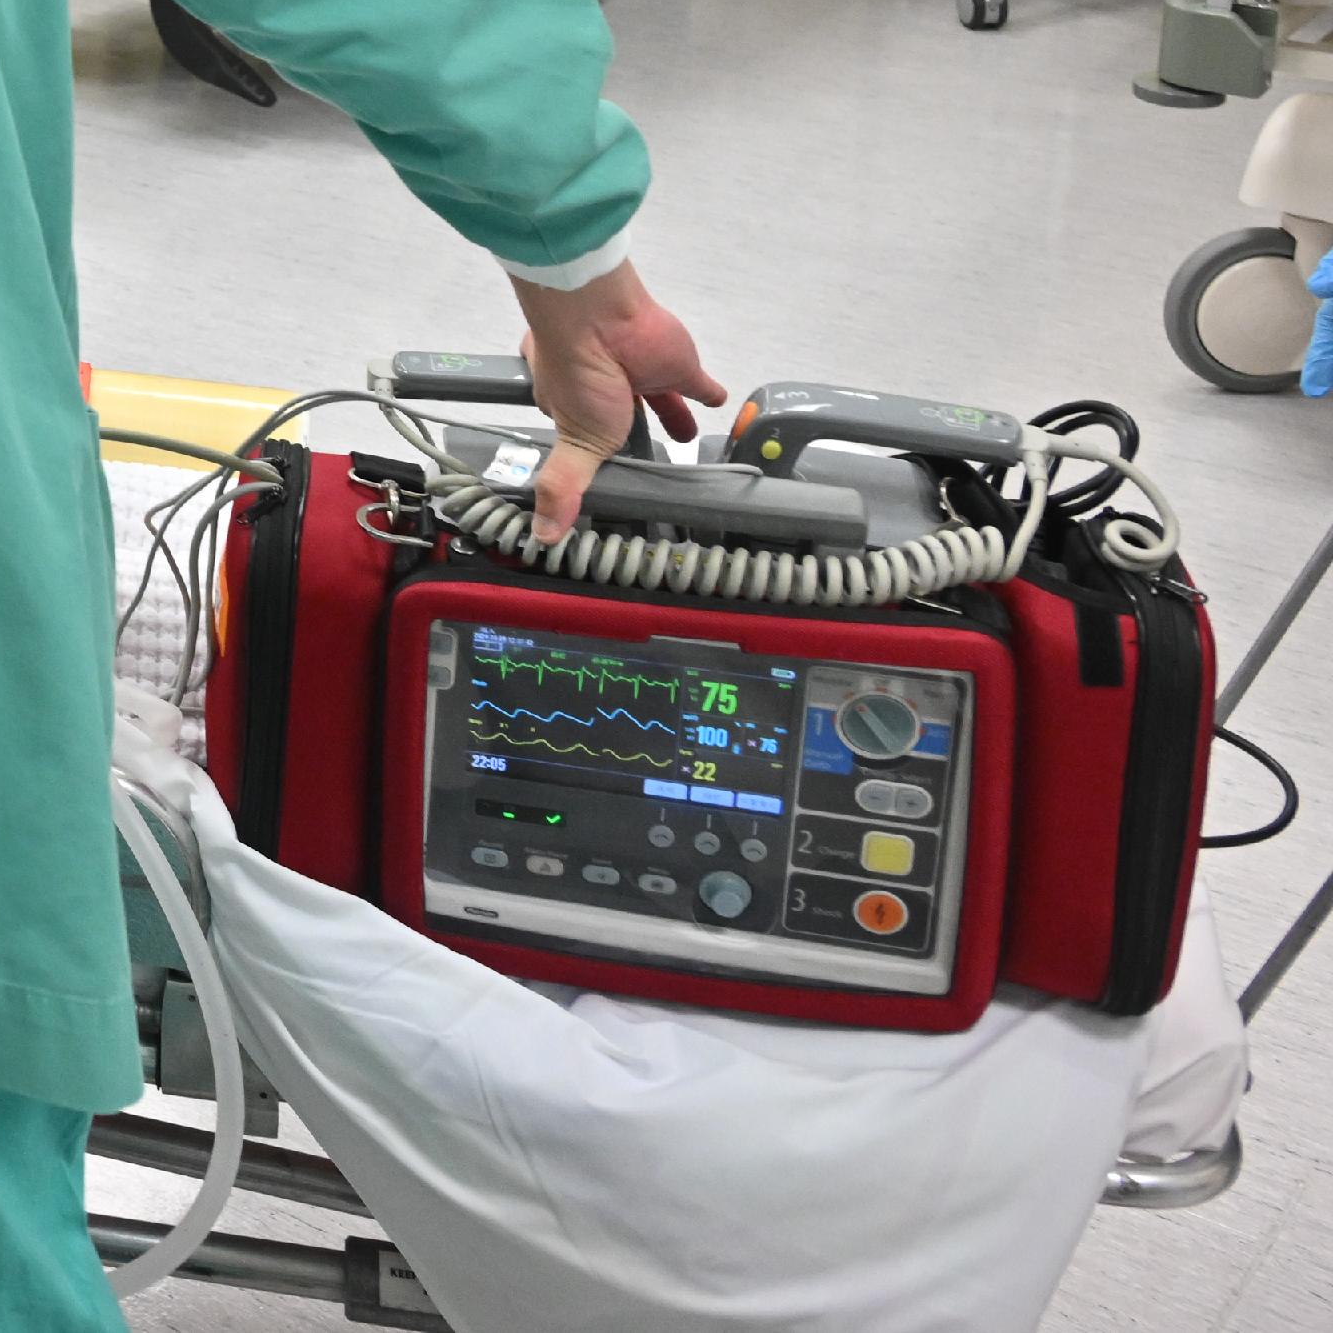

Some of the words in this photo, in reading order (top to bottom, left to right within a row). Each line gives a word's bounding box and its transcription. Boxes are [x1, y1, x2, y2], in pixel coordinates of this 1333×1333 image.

[701, 681, 738, 714] 75
[696, 726, 728, 747] 100
[471, 755, 507, 772] 22:05
[692, 761, 717, 782] 22
[797, 830, 813, 854] 2
[791, 889, 806, 912] 3
